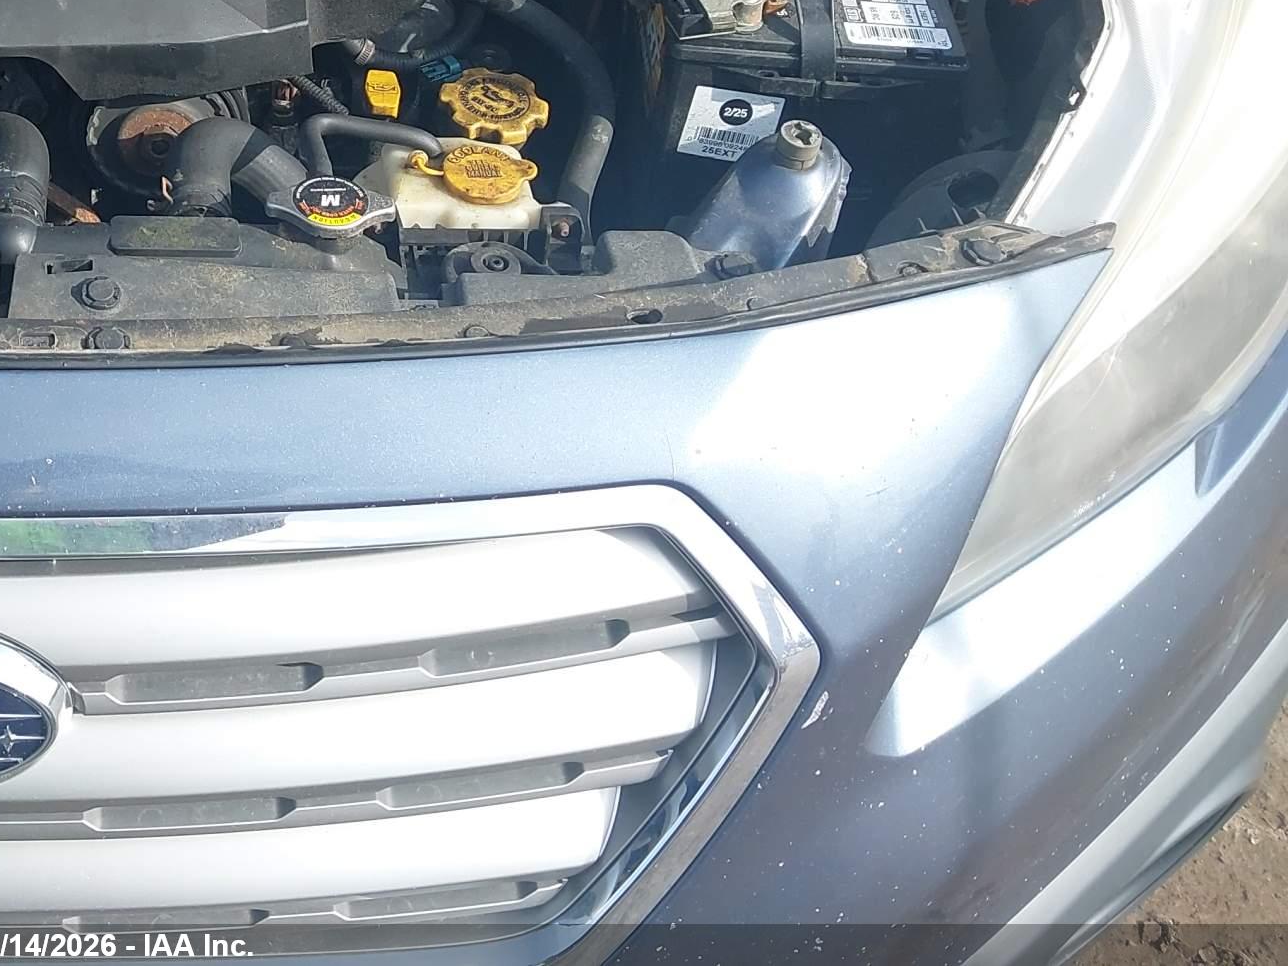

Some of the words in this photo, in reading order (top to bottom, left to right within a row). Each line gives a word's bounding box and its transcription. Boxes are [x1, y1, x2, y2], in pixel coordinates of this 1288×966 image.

[723, 106, 749, 118] 2/25
[447, 145, 510, 164] COOLANT
[702, 145, 738, 158] 25EXT
[320, 194, 340, 207] M
